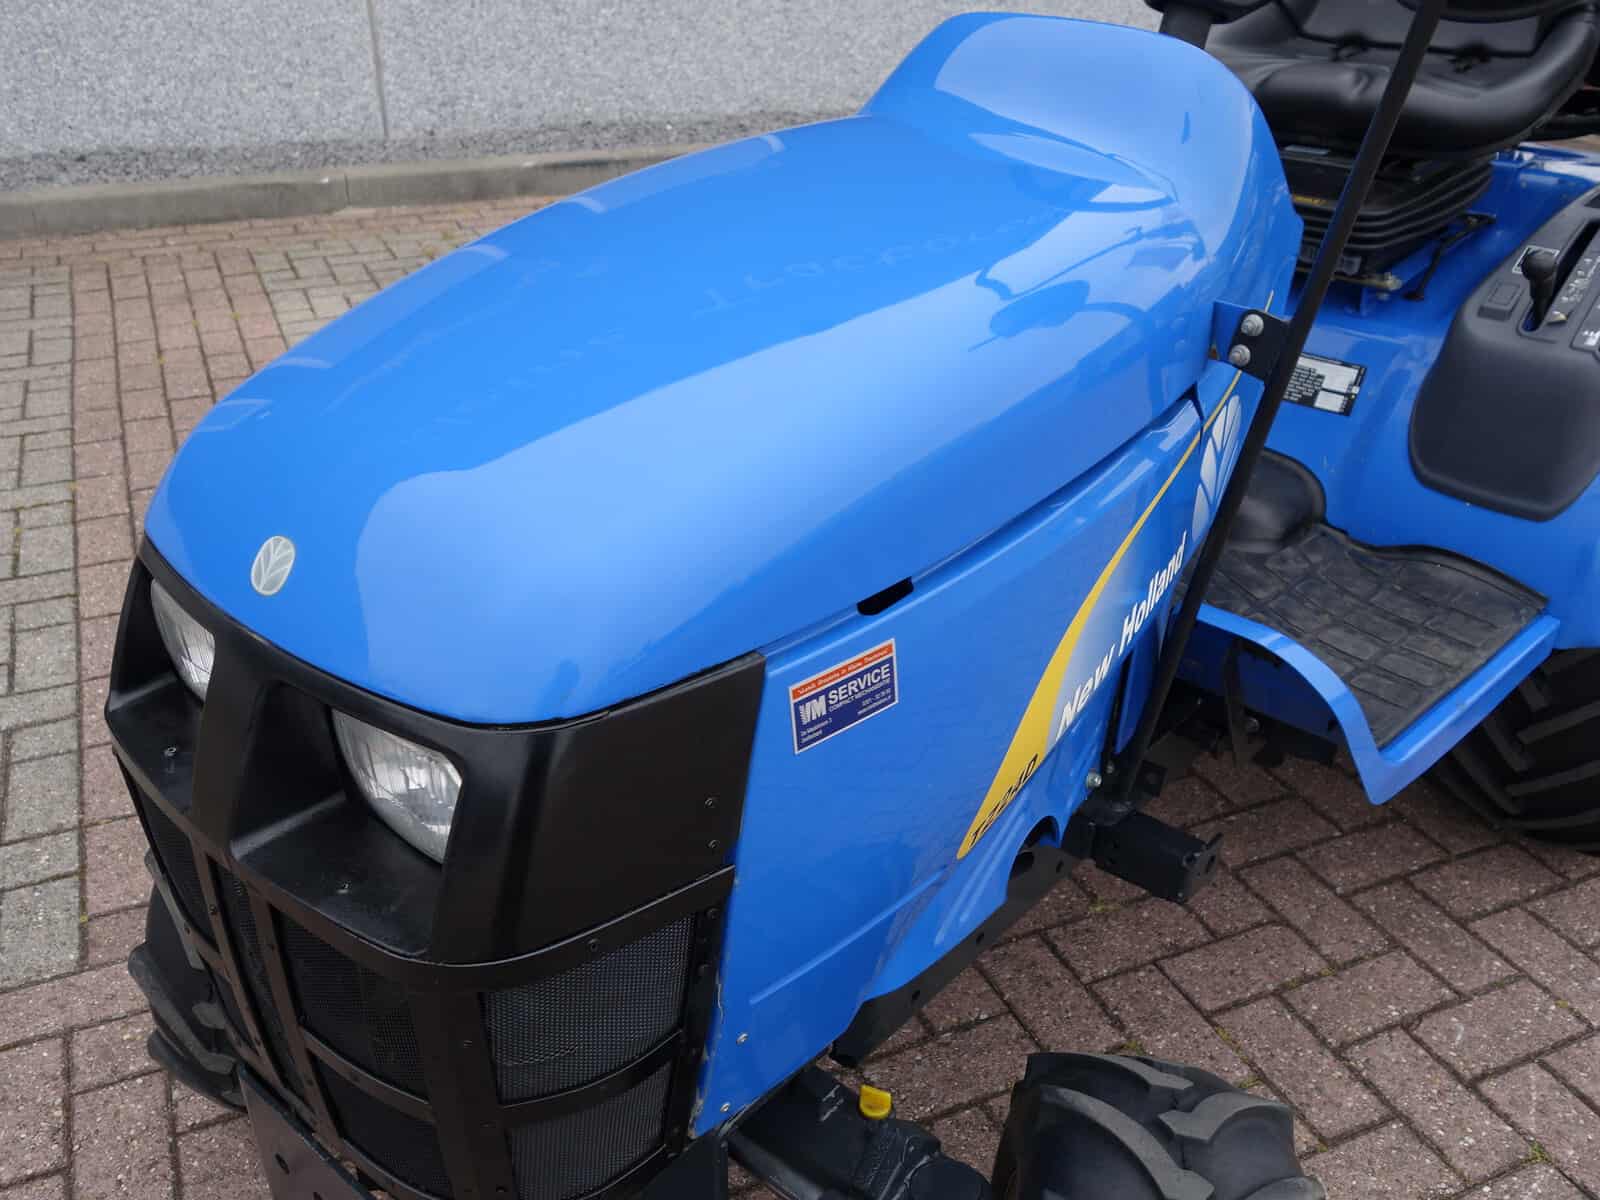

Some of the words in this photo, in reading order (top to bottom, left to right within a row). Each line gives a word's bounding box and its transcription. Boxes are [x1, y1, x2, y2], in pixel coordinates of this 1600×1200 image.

[828, 663, 891, 705] SERVICE
[1055, 643, 1115, 742] New
[1118, 530, 1187, 657] Holland
